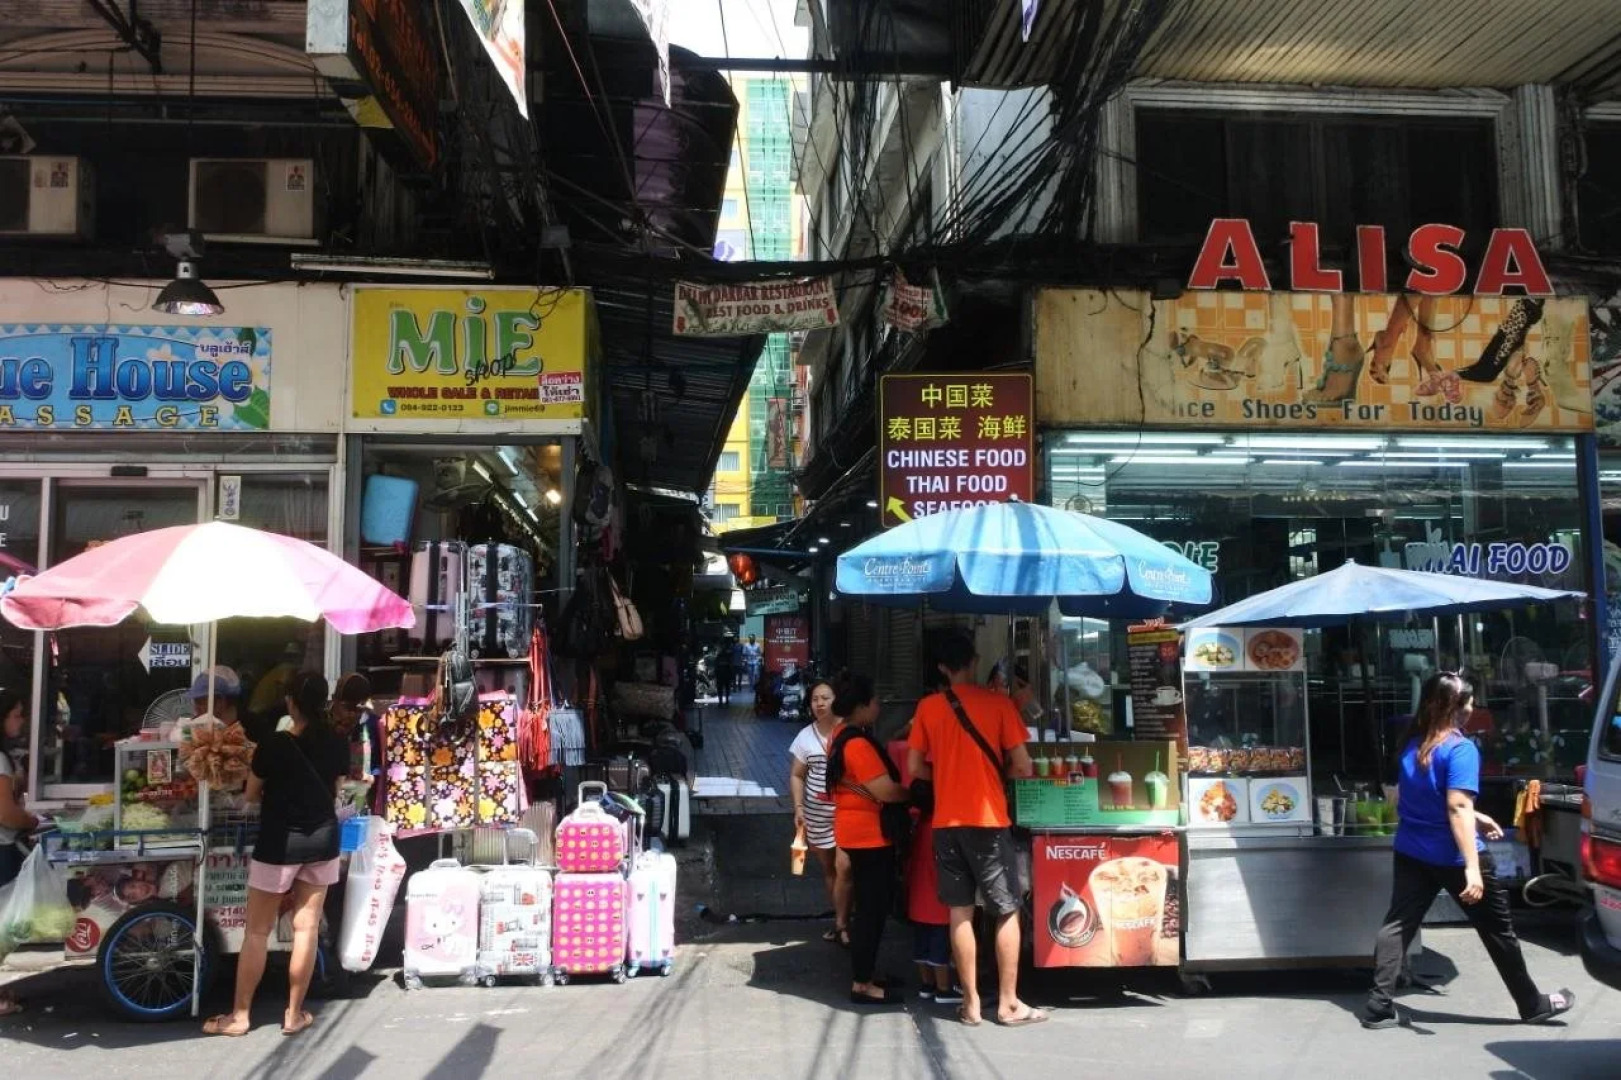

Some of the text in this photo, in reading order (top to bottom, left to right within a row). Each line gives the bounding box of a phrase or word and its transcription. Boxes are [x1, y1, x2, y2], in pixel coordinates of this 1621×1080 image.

[1187, 218, 1556, 296] ALISA
[736, 302, 770, 317] FOOD
[69, 336, 253, 402] House
[387, 386, 438, 400] WHOLE
[921, 383, 994, 409] 中国菜
[1243, 399, 1317, 422] Shoes
[1344, 401, 1384, 421] For
[1410, 401, 1484, 427] Today
[888, 414, 1027, 441] 泰国菜 海鲜
[888, 449, 1026, 468] CHINESE FOOD
[907, 475, 1008, 493] THAI FOOD
[1488, 542, 1570, 574] FOOD
[151, 643, 188, 654] SLIDE
